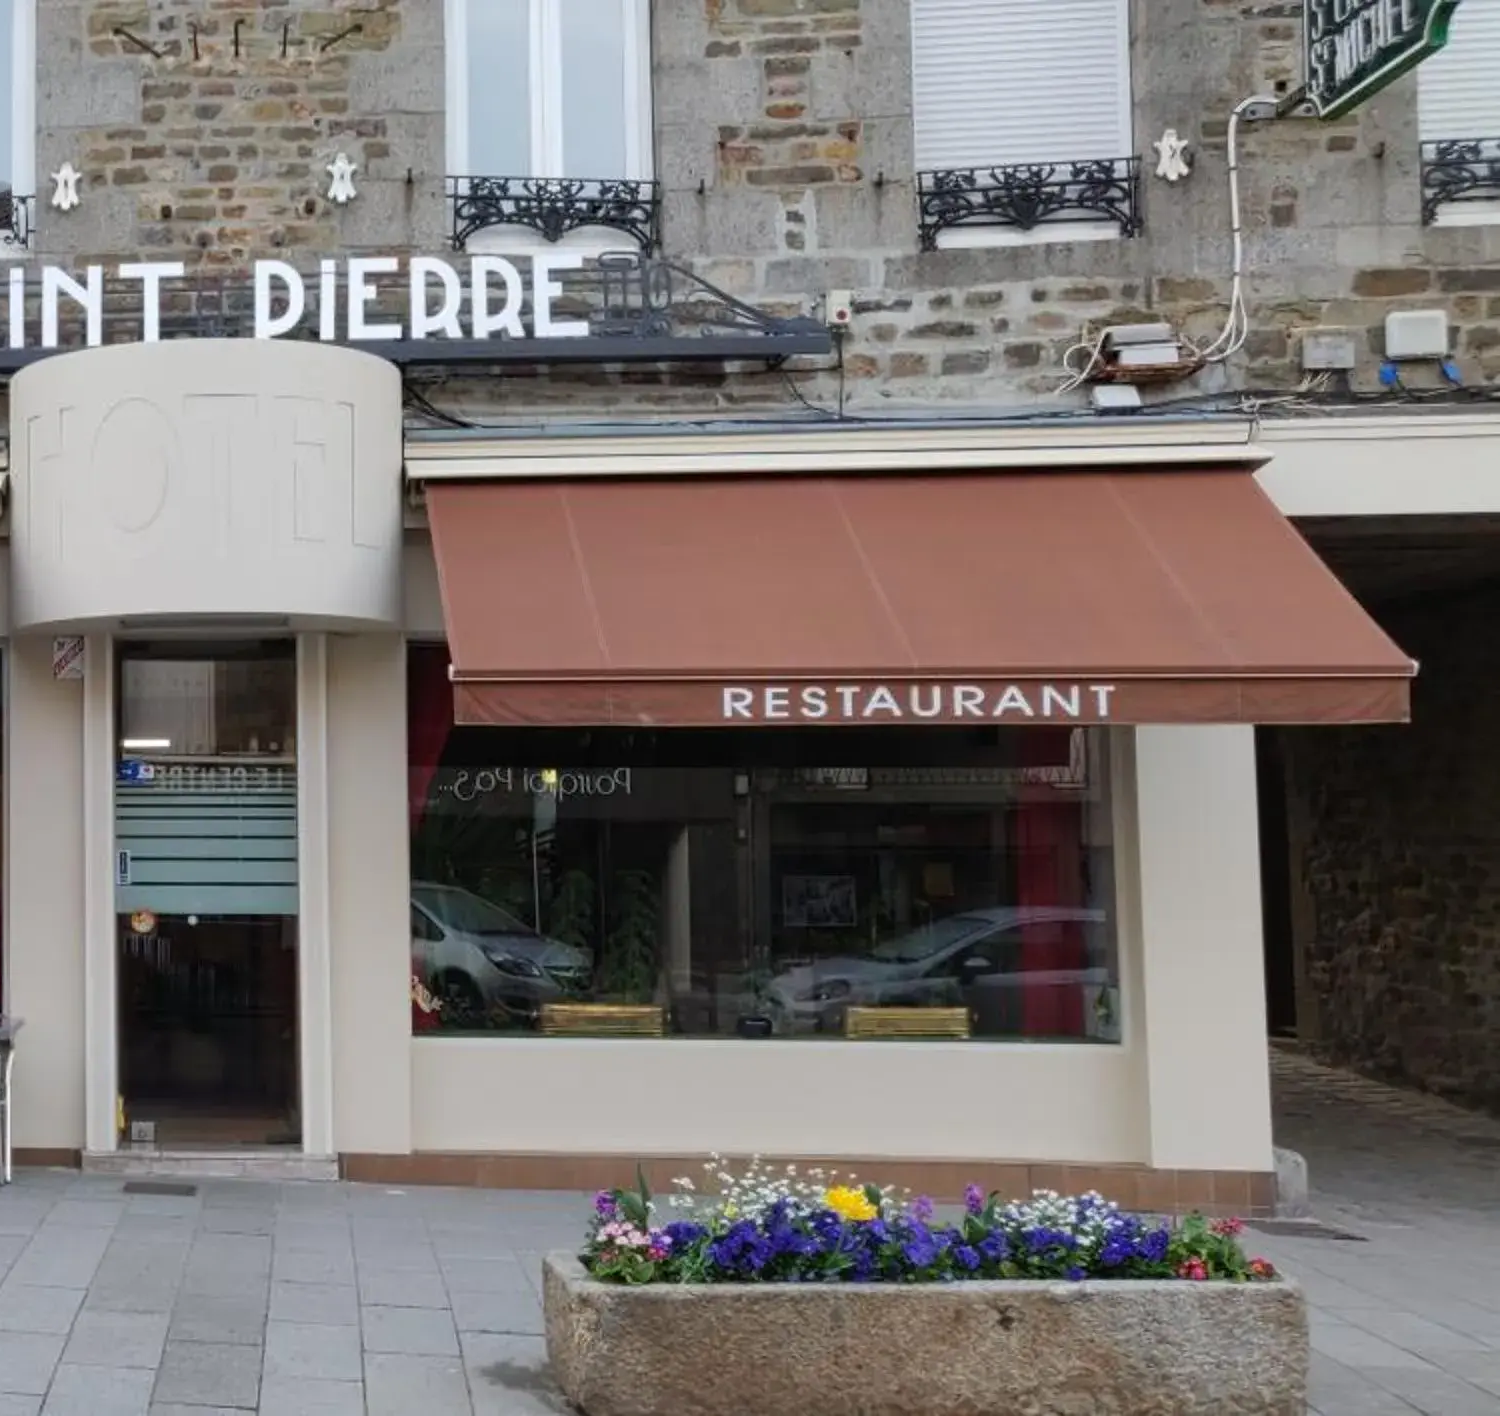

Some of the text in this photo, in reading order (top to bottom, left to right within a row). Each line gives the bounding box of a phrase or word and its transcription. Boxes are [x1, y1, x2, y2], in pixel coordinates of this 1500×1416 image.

[254, 253, 590, 341] PIERRE
[26, 393, 383, 563] HOTEL
[722, 685, 1116, 718] RESTAURANT
